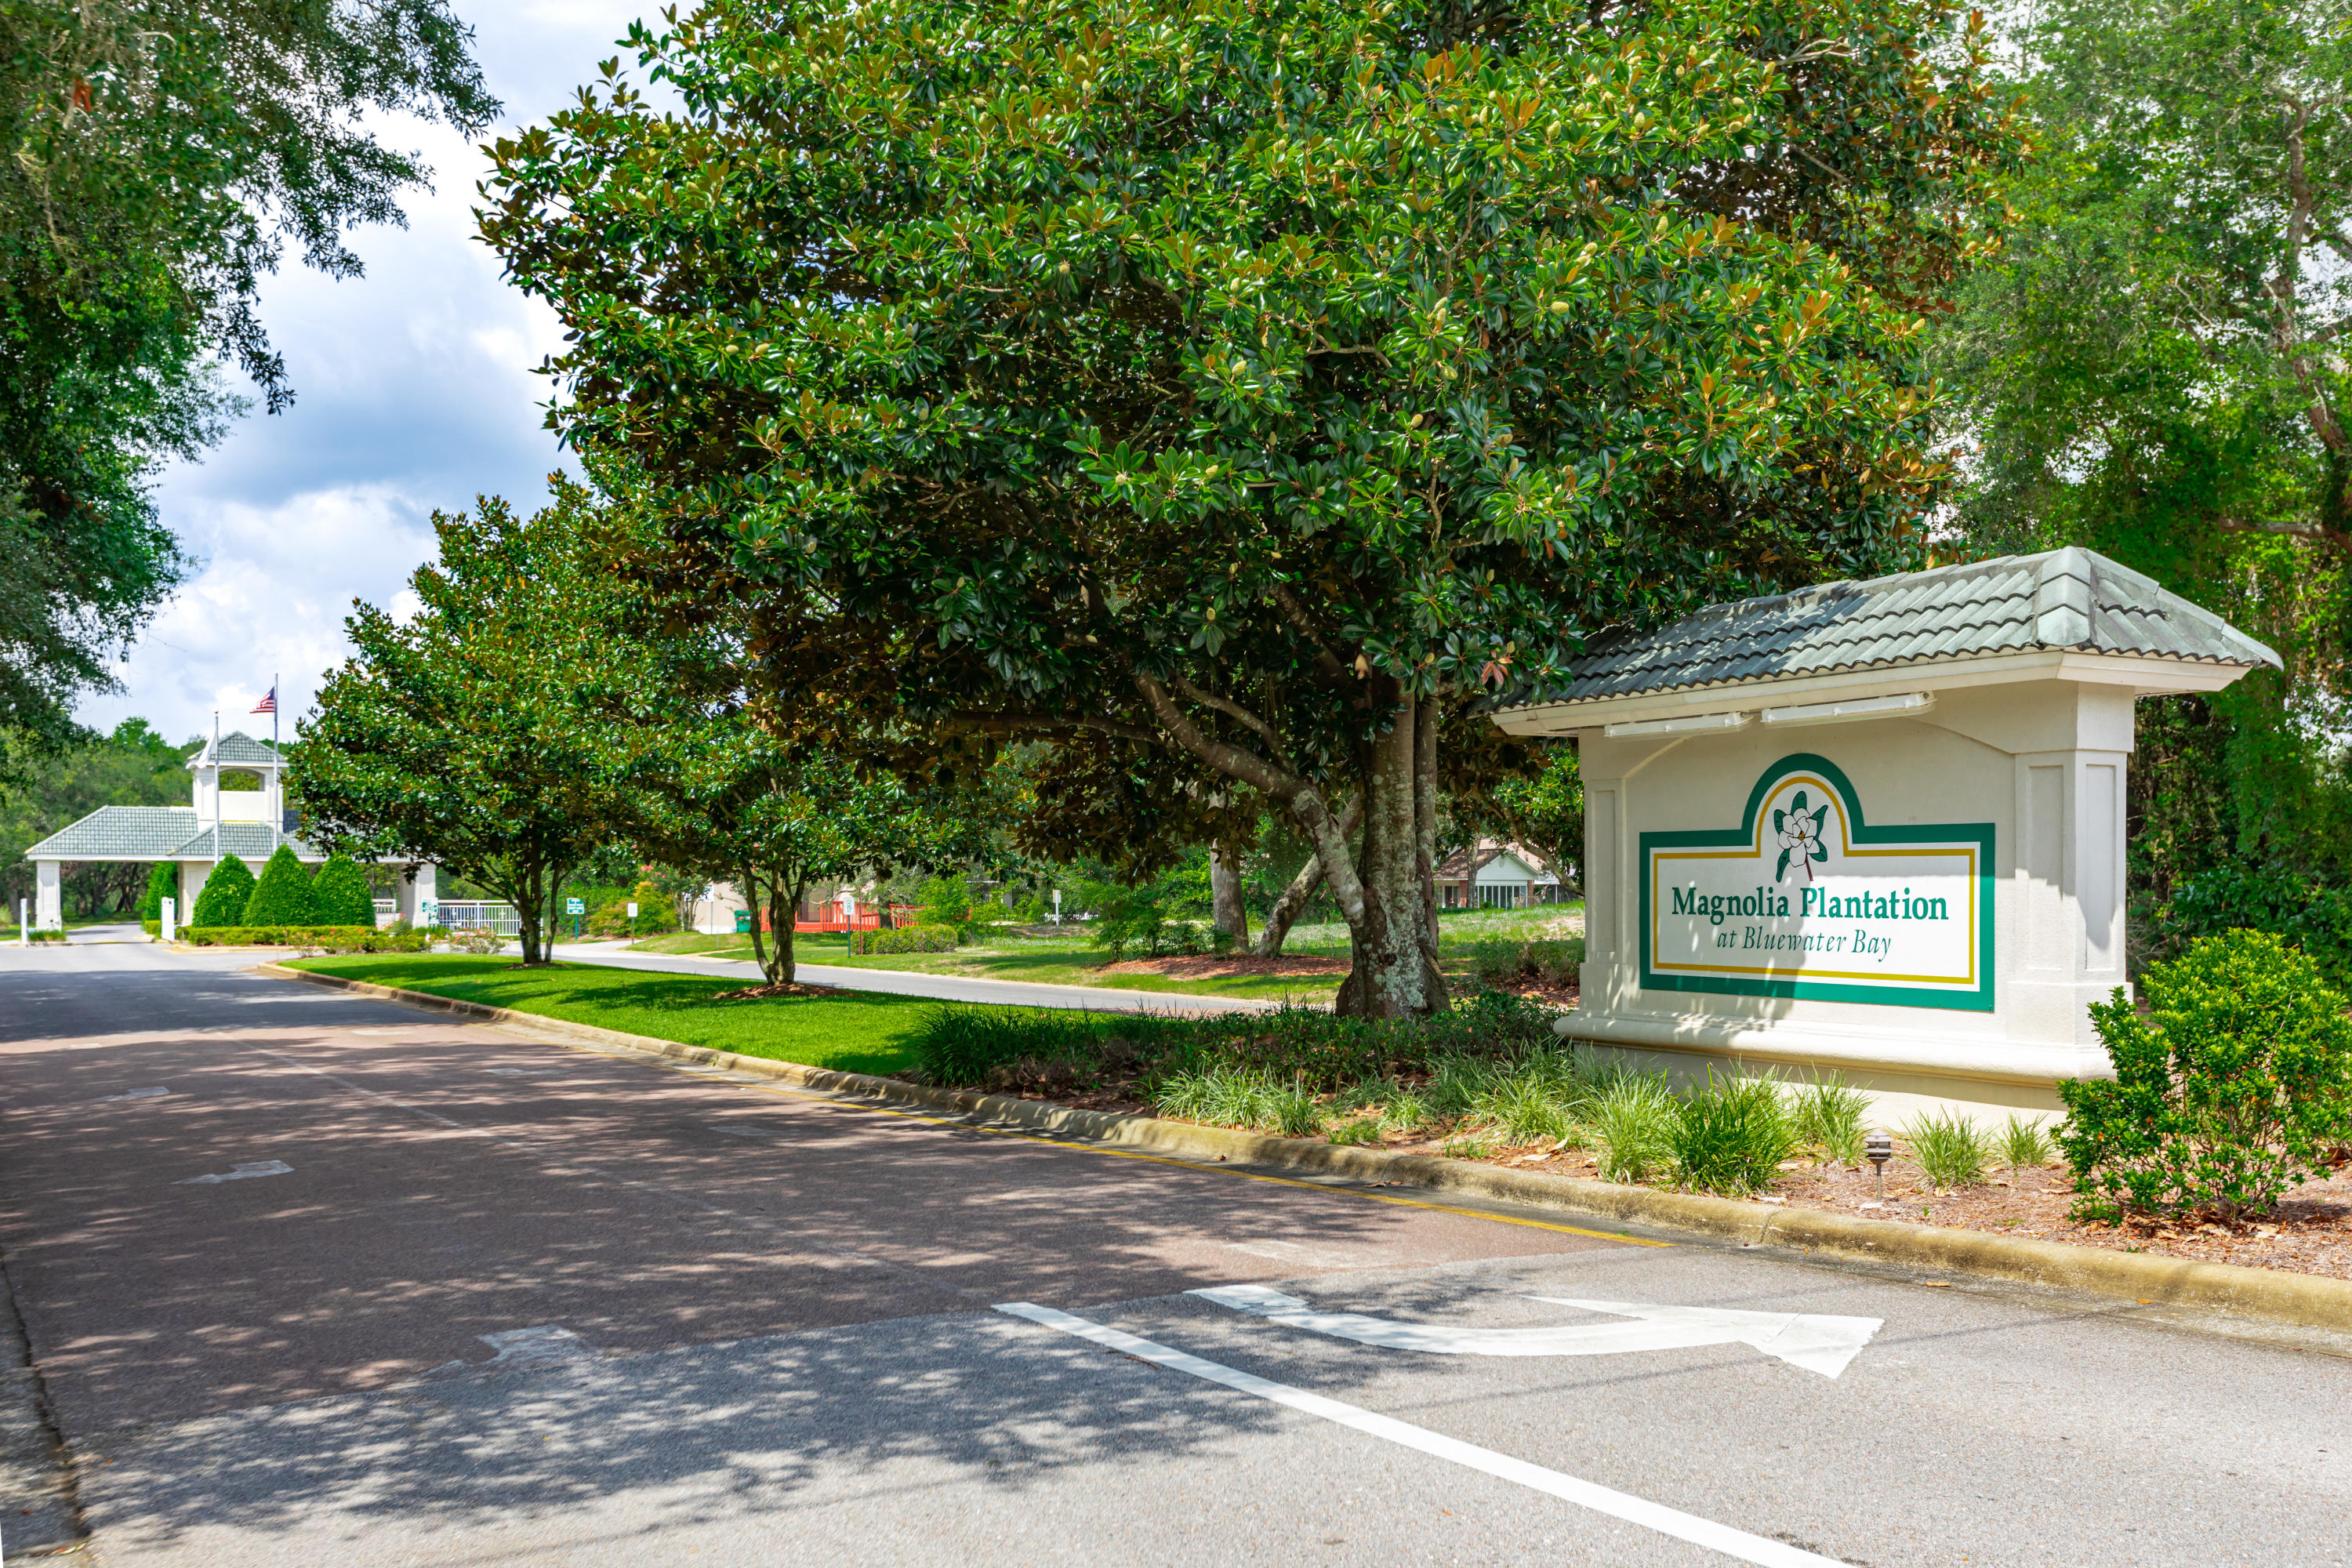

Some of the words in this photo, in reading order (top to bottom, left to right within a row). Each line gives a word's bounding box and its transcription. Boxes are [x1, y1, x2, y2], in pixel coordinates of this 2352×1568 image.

[1671, 886, 1791, 926] Magnolia
[1799, 886, 1949, 920] Plantation
[1716, 928, 1737, 949] at
[1741, 925, 1847, 953] Bluewater
[1851, 929, 1892, 963] Bay
